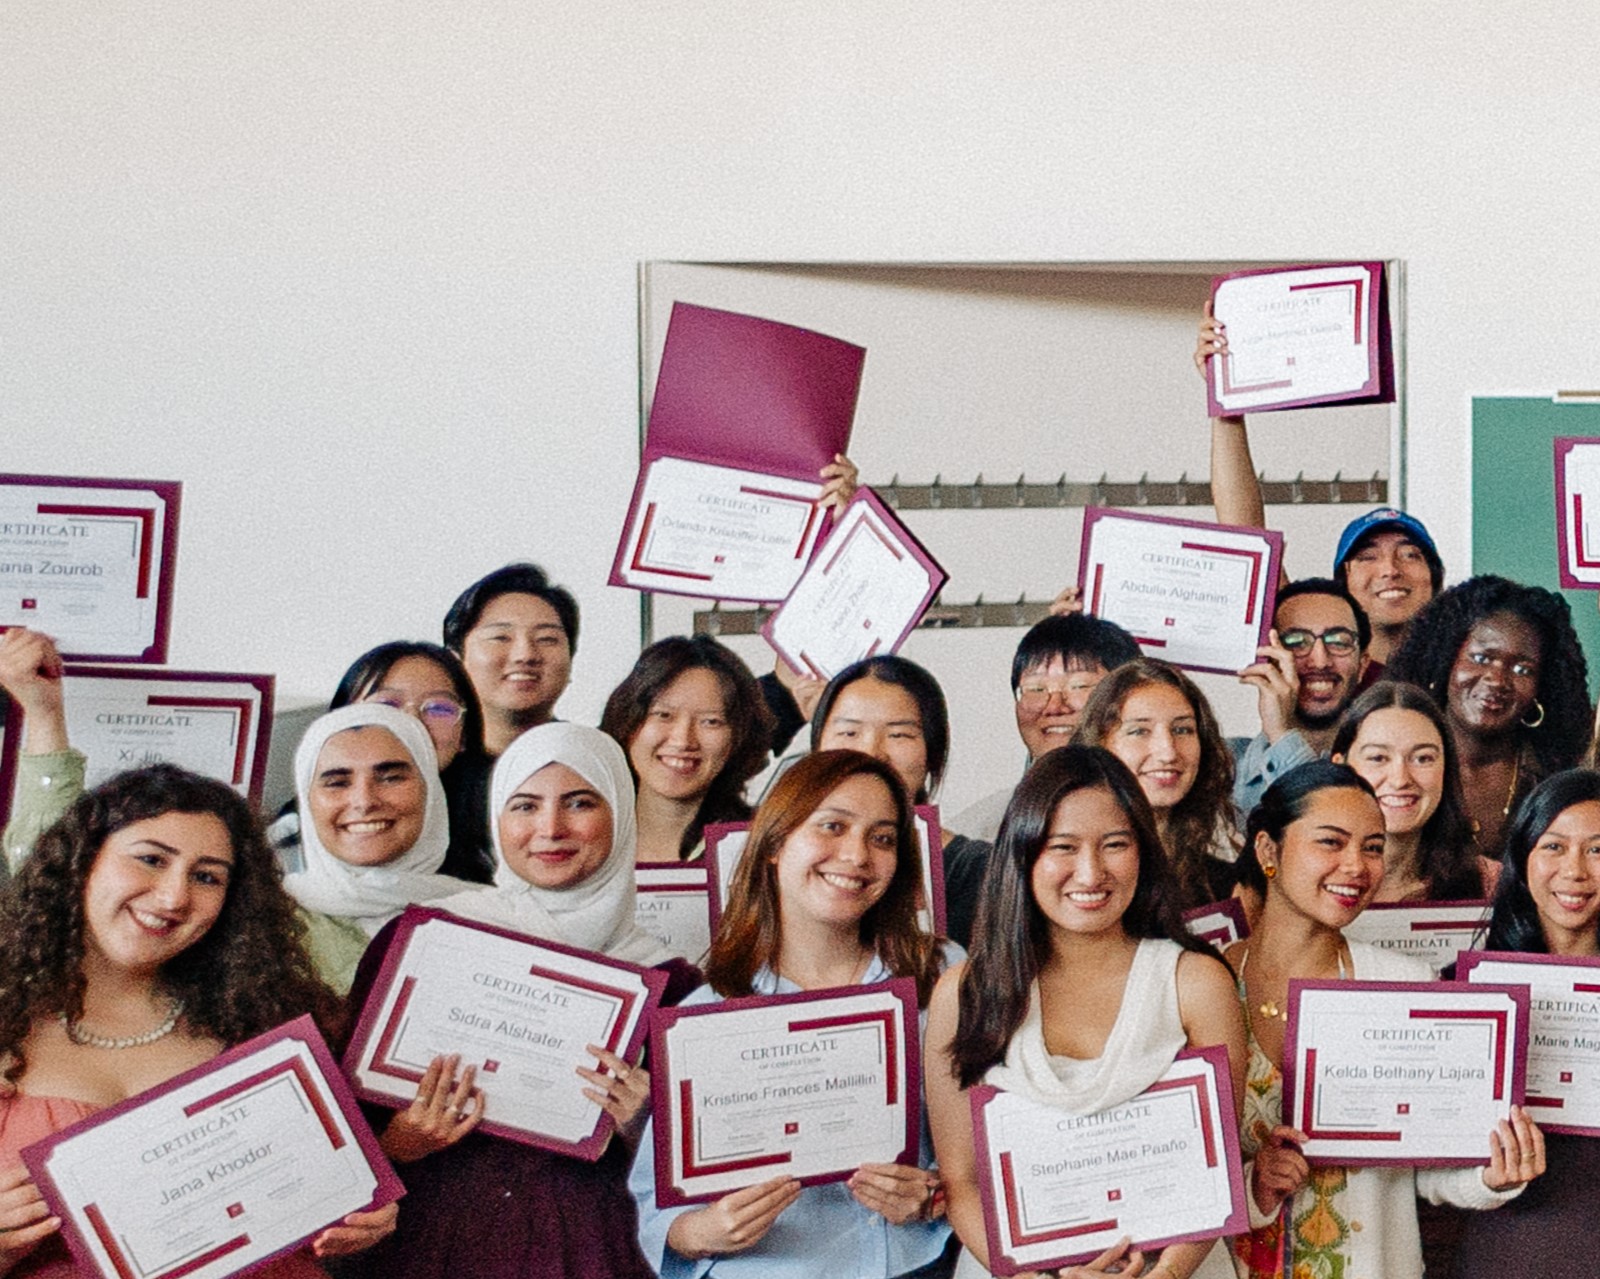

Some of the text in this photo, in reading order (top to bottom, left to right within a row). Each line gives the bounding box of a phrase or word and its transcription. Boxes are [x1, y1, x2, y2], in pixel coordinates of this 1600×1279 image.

[698, 493, 772, 514] CERTIFICATE
[0, 523, 90, 538] RTIFICATE
[0, 562, 103, 577] ana Zourob
[1142, 552, 1216, 572] CERTIFICATE
[1120, 579, 1229, 608] Abdulla Alghanim
[96, 714, 193, 727] CERTIFICATE
[472, 972, 571, 1009] CERTIFICATE
[449, 1006, 566, 1051] Sidra Alshater
[1362, 1028, 1453, 1042] CERTIFICATE
[740, 1039, 839, 1061] CERTIFICATE
[1534, 1034, 1570, 1048] Marie
[1324, 1064, 1486, 1083] Kelda Bethany Lajara
[703, 1091, 758, 1108] Kristine
[763, 1082, 821, 1100] Frances
[1057, 1105, 1152, 1132] CERTIFICATE
[140, 1106, 252, 1165] CERTIFICATE
[159, 1178, 205, 1207] Jana
[206, 1140, 275, 1184] Khodor
[1031, 1154, 1103, 1178] Stephanie
[1107, 1147, 1138, 1162] Mae
